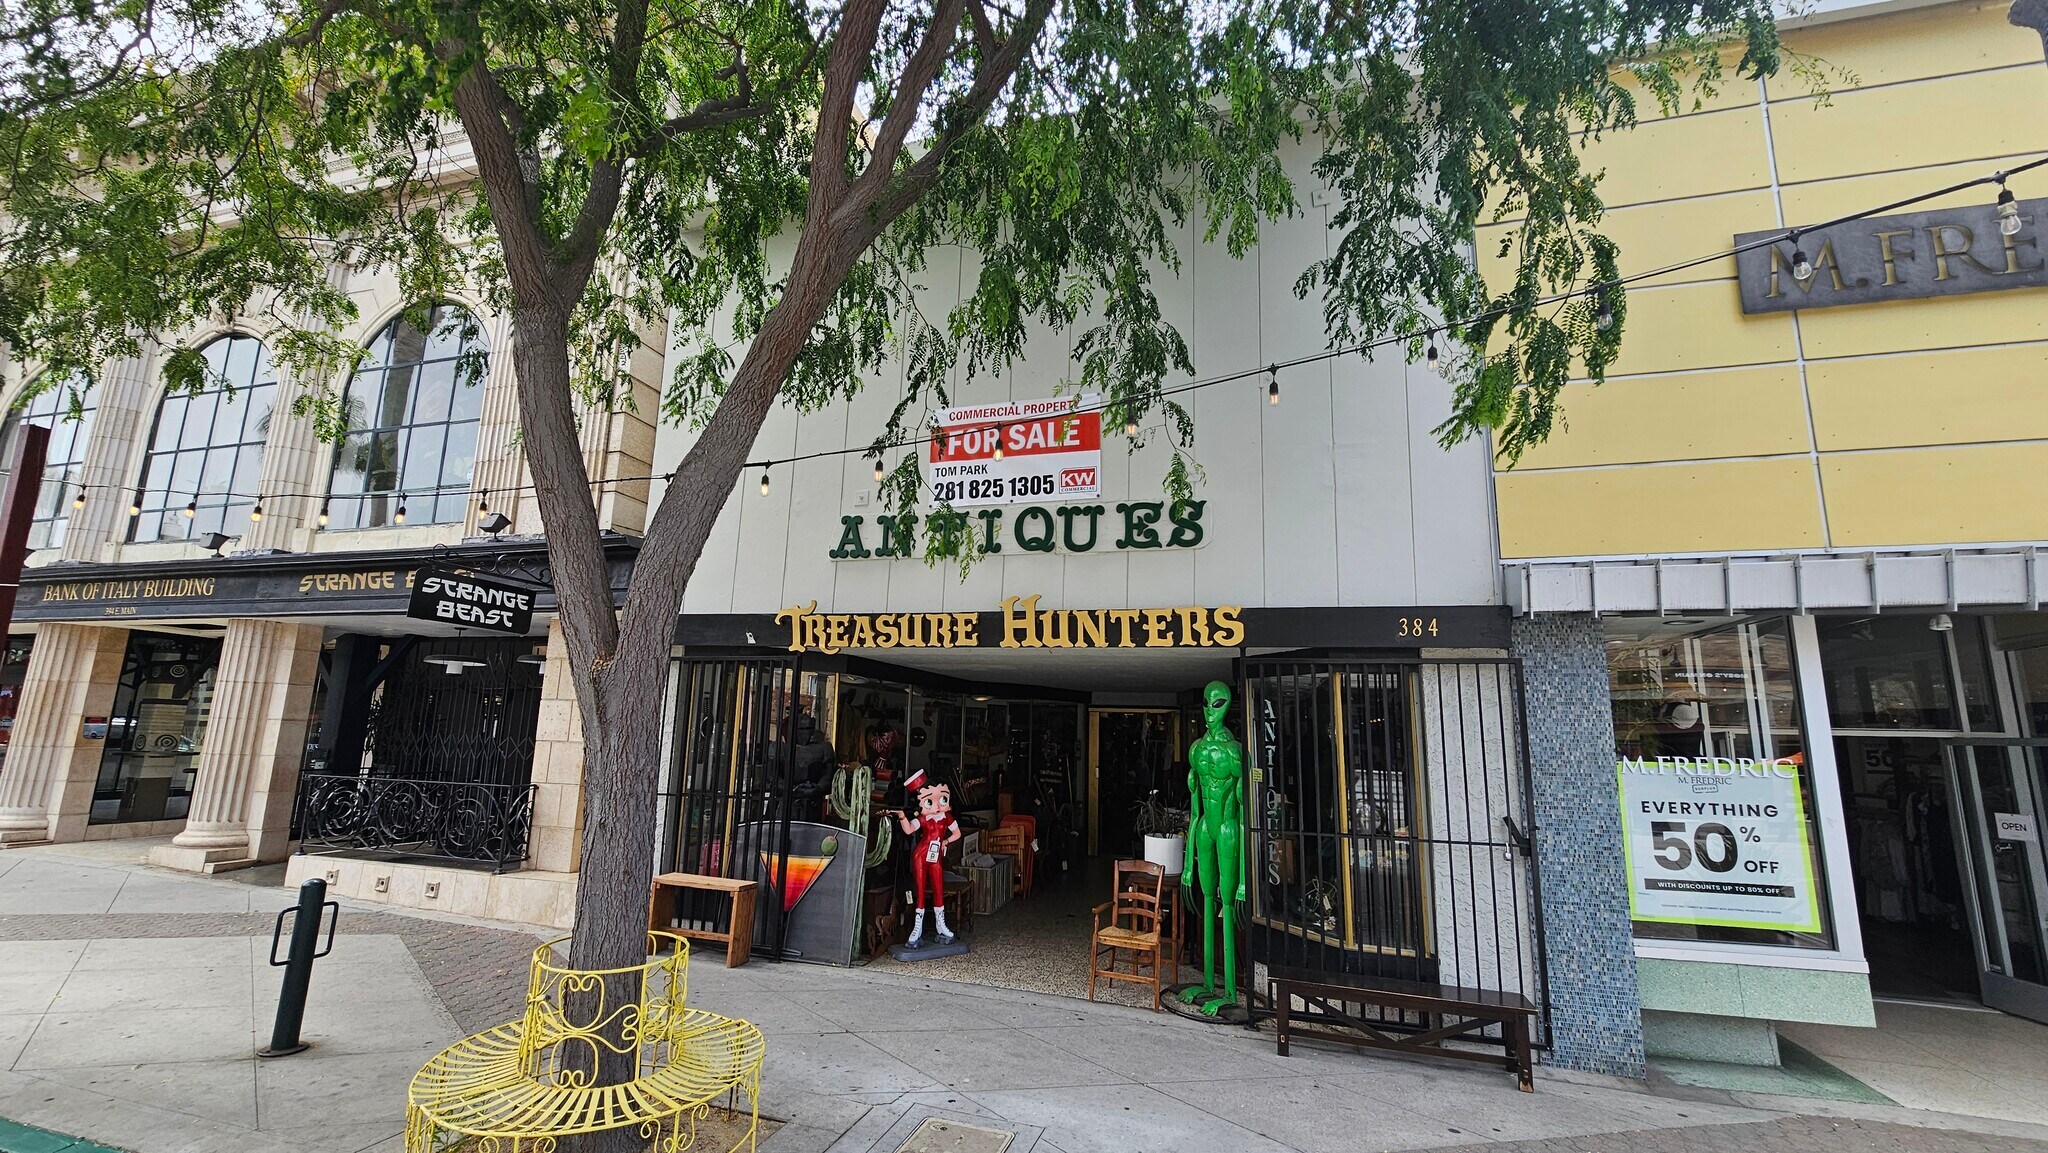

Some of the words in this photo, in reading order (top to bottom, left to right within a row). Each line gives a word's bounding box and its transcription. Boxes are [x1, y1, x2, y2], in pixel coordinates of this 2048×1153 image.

[949, 406, 1021, 422] COMMERCIAL
[1023, 399, 1081, 415] PROPERT
[948, 428, 1000, 456] FOR
[1008, 419, 1081, 451] SALE
[935, 466, 957, 478] TOM
[960, 464, 988, 476] PARK
[1061, 471, 1095, 487] KW
[933, 480, 964, 502] 281
[968, 478, 1004, 499] 825
[1008, 474, 1055, 497] 1305
[42, 583, 81, 602] BANK
[82, 582, 101, 600] OF
[101, 580, 144, 599] ITALY
[143, 577, 216, 598] BUILDING
[299, 571, 396, 592] STRANGE
[422, 577, 530, 611] STRANGE
[121, 606, 138, 615] MAIN
[436, 600, 514, 628] BEAST
[774, 600, 979, 654] TREASURE
[999, 594, 1247, 649] HUNTERS
[1398, 618, 1439, 637] 384
[1678, 776, 1690, 784] M.
[1690, 776, 1733, 786] FREDRIC
[1641, 800, 1778, 818] EVERYTHING
[2001, 821, 2027, 833] OPEN
[1743, 859, 1779, 875] OFF
[1657, 880, 1677, 889] WITH
[1677, 882, 1721, 892] DISCOUNTS
[1747, 886, 1764, 895] 80%
[1765, 887, 1780, 895] OFF
